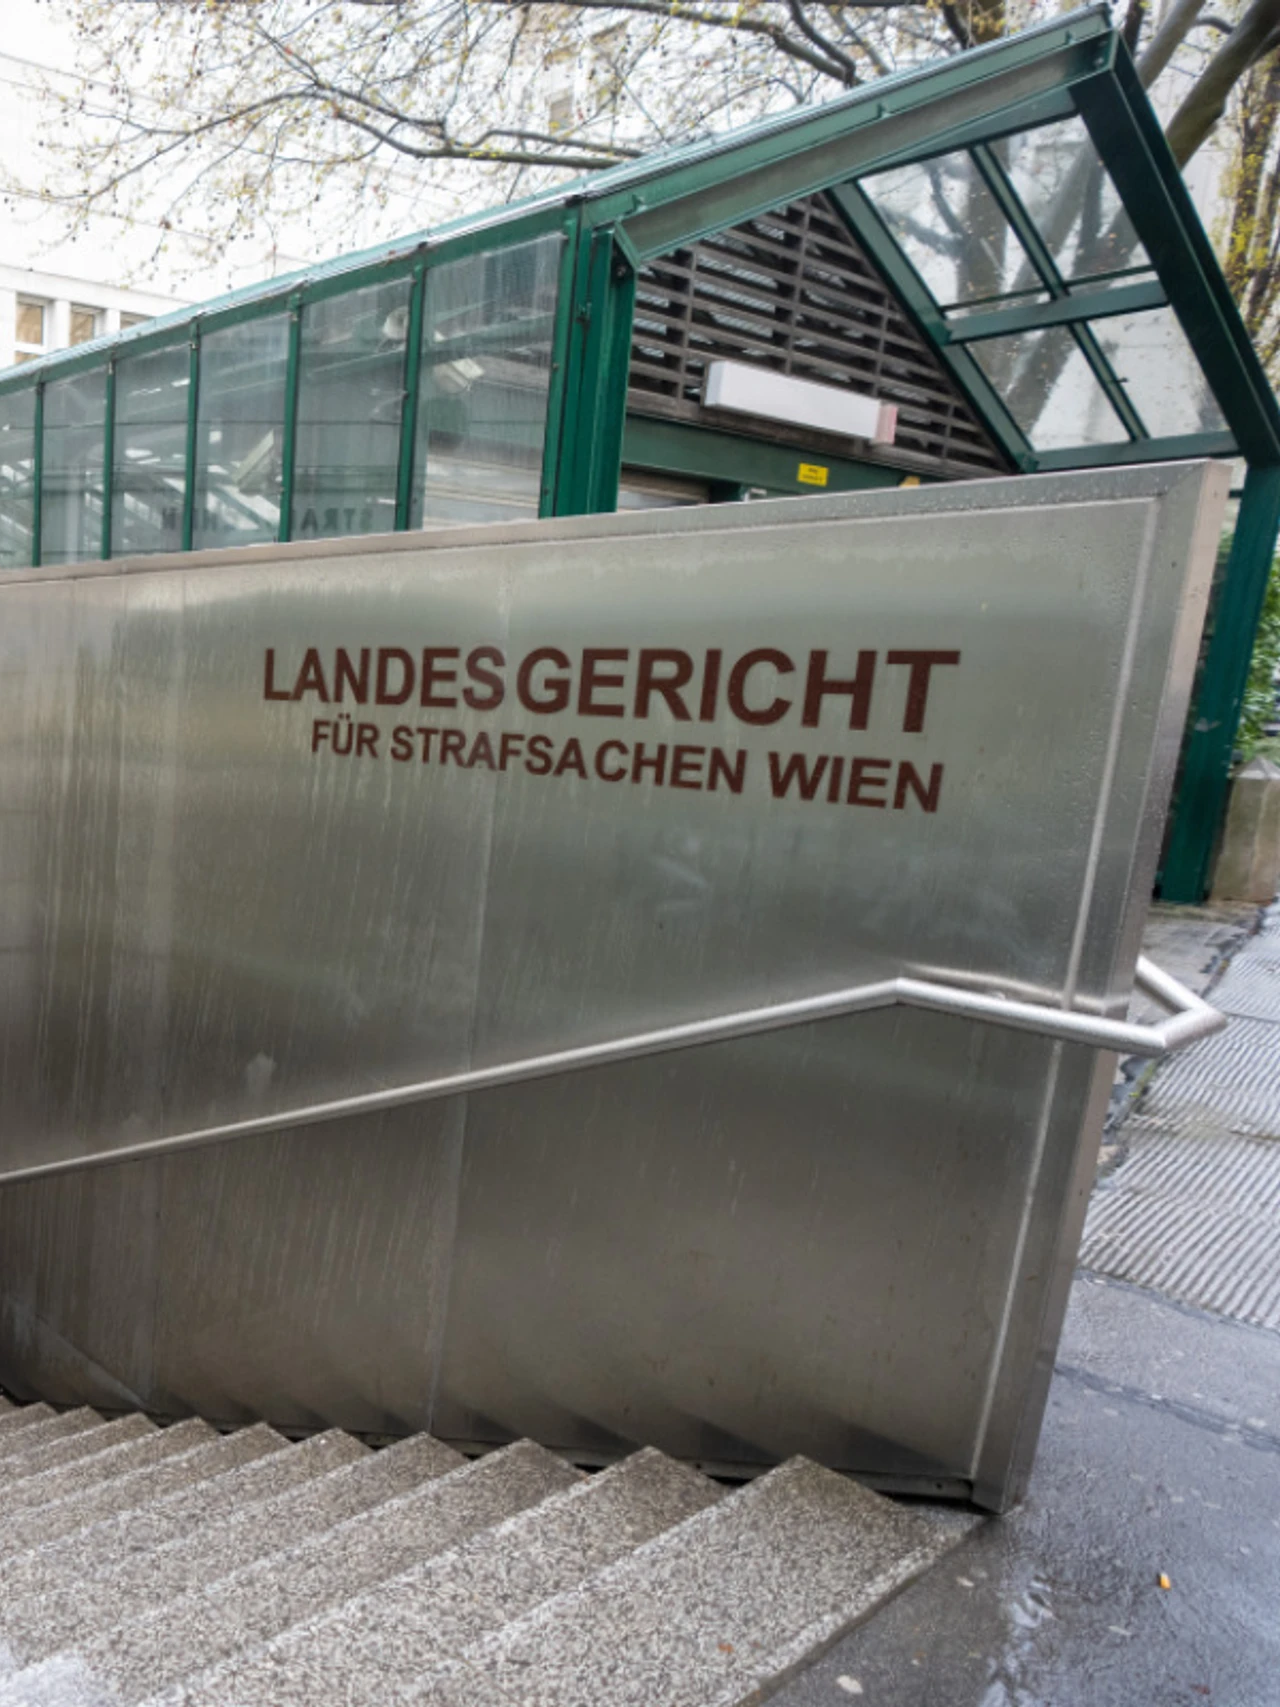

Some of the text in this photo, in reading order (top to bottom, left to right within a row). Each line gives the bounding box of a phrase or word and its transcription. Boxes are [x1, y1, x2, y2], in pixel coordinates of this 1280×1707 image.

[264, 645, 961, 733] LANDESGERICHT
[311, 713, 944, 814] FÜR STRAFSACHEN WIEN
